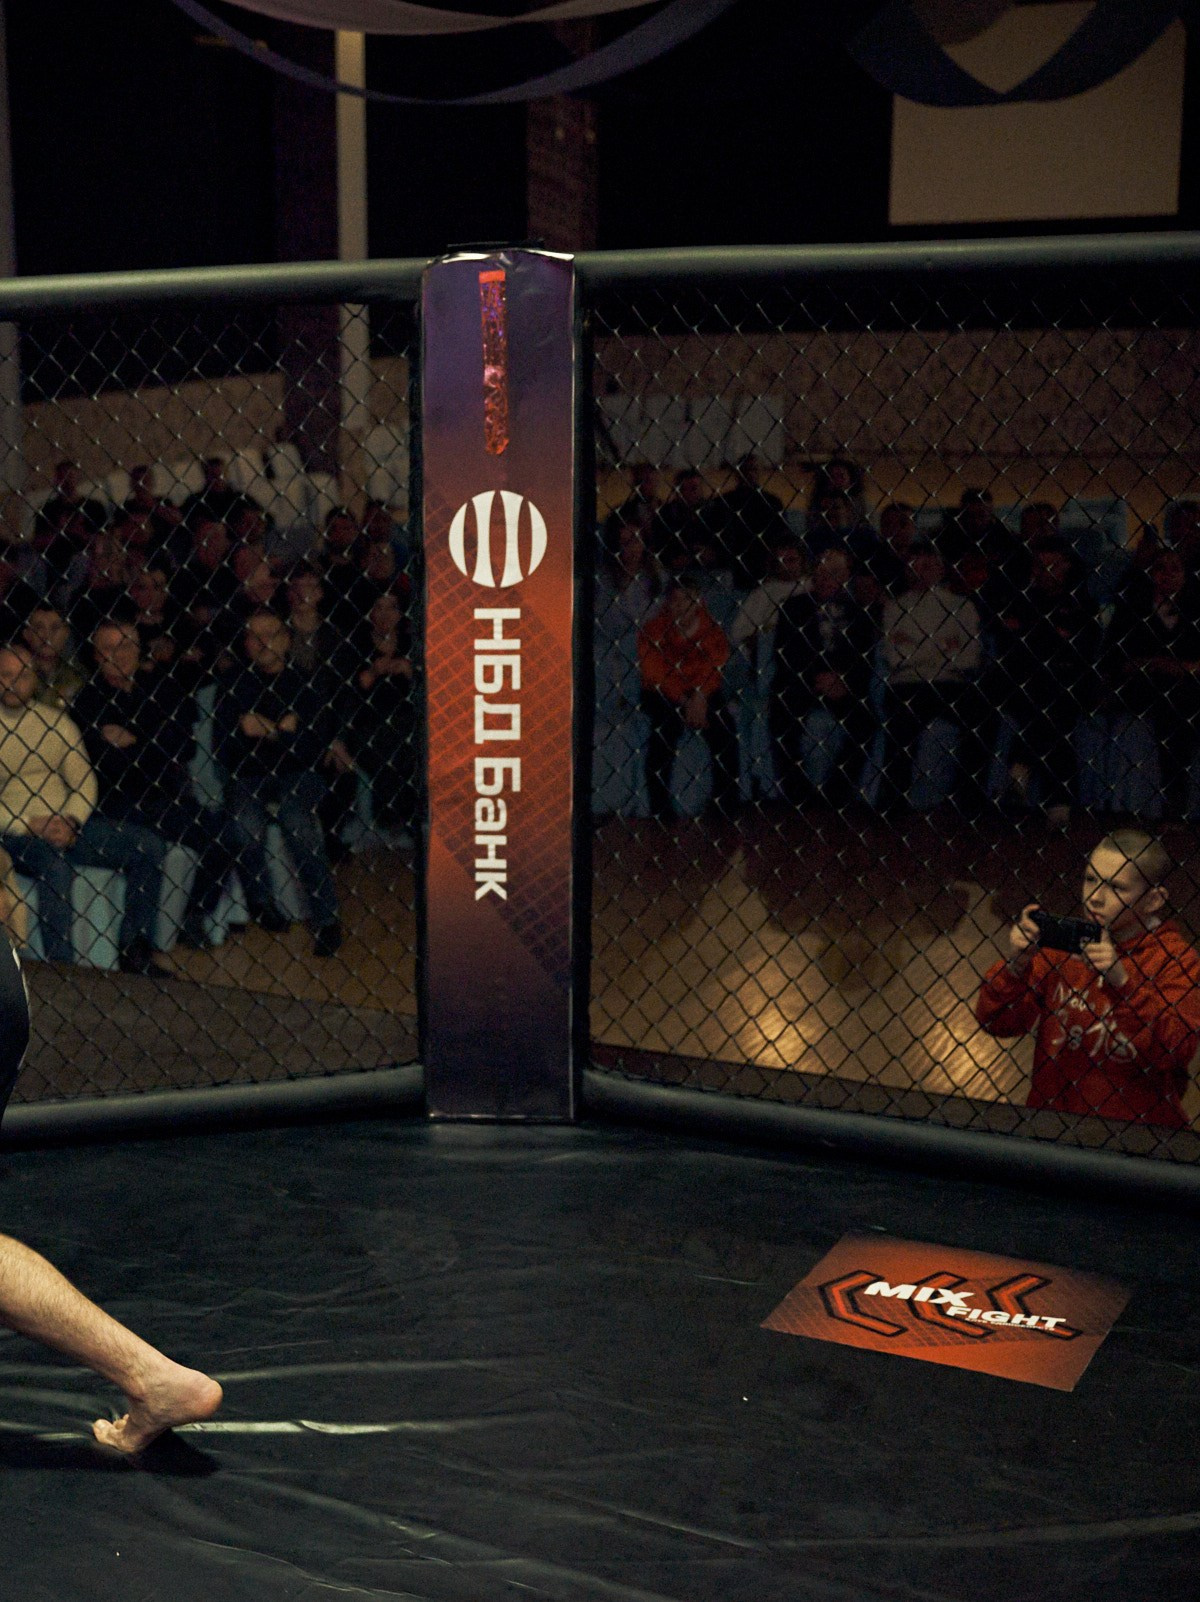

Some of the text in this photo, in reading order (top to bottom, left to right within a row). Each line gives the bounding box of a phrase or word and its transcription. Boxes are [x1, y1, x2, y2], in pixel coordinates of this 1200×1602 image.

[474, 608, 521, 901] НБД Банк
[863, 1281, 975, 1308] MIX
[946, 1306, 1067, 1329] FIGHT
